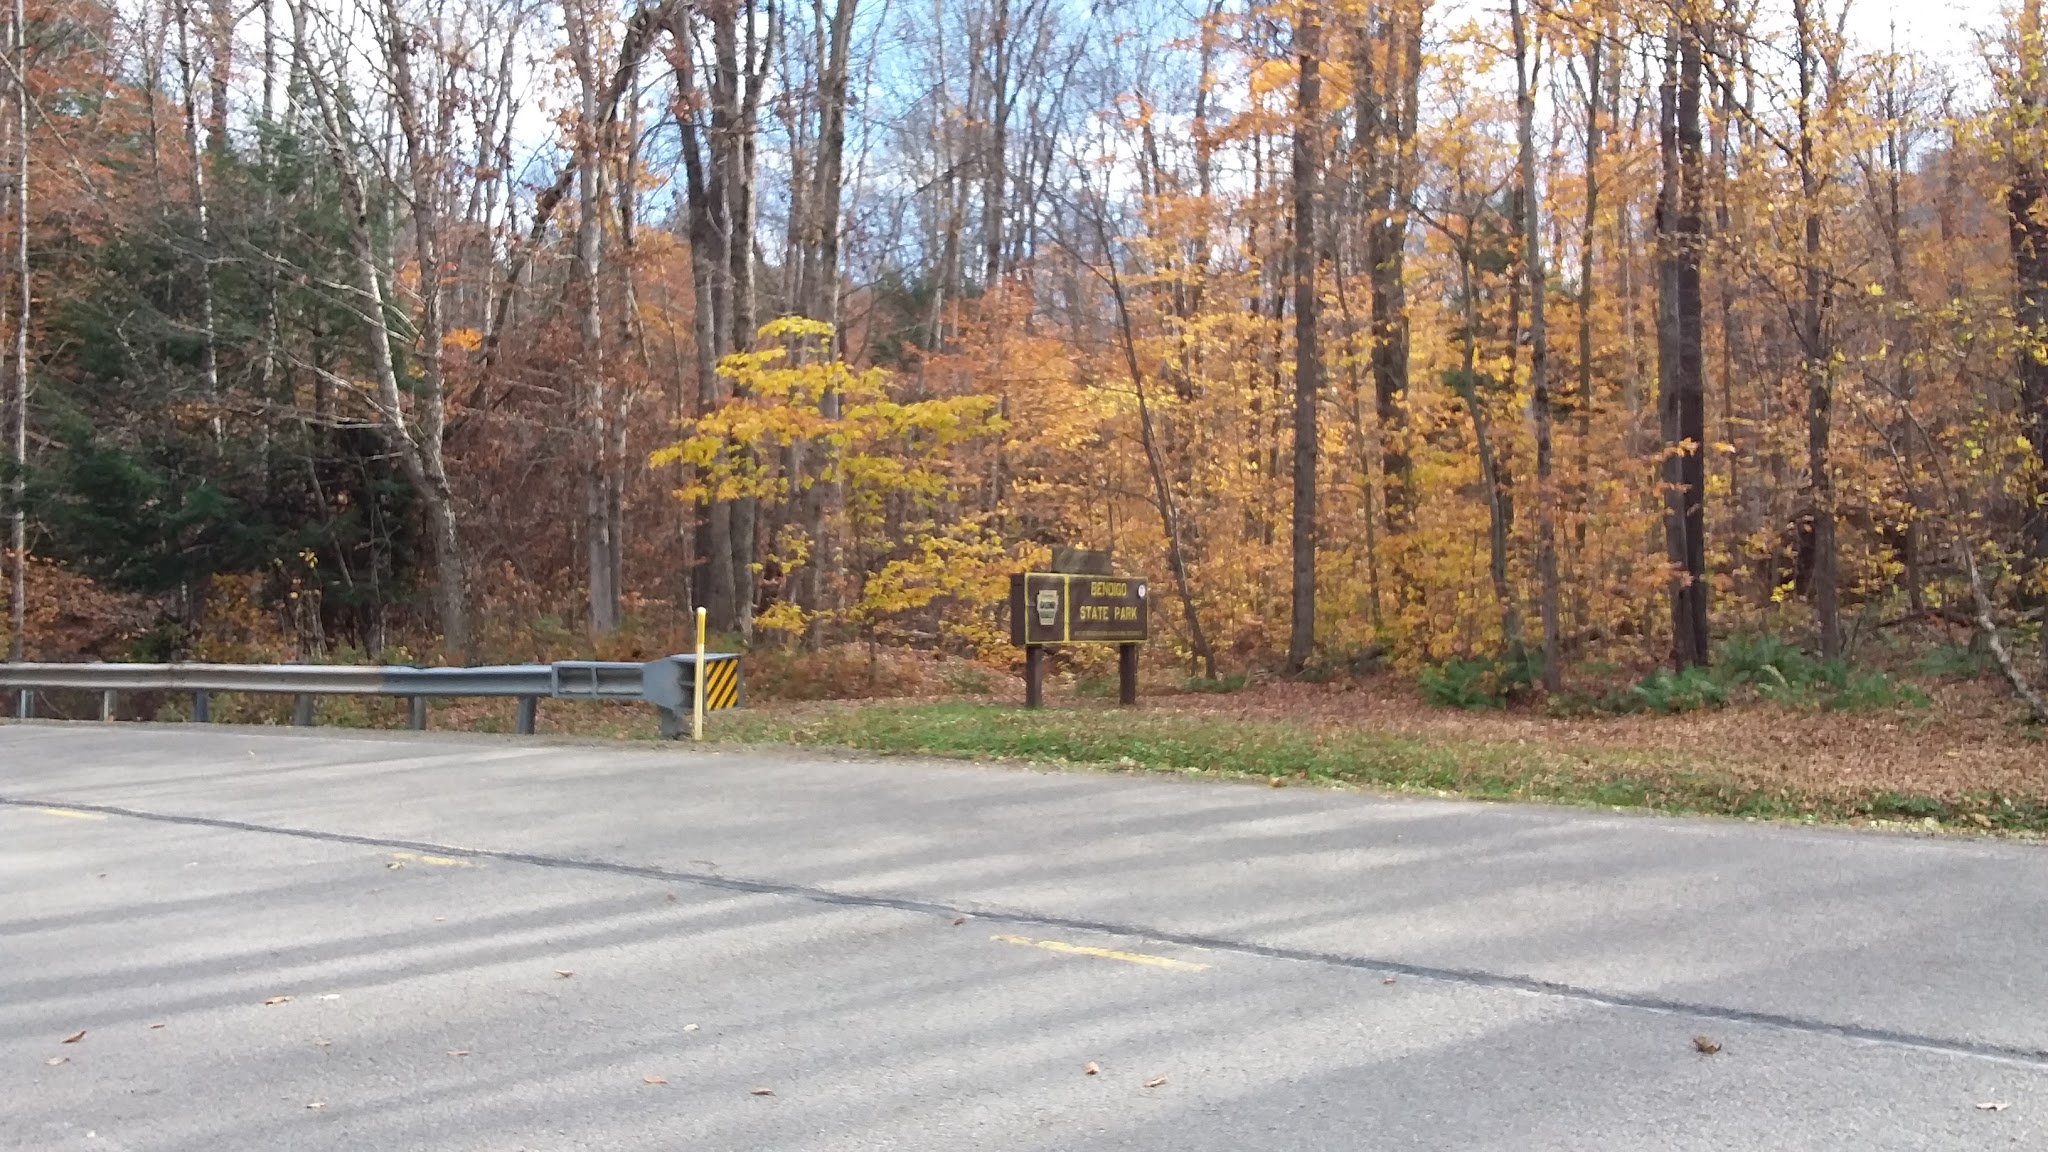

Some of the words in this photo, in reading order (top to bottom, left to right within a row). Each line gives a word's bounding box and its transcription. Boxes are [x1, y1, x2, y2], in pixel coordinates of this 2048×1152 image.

[1090, 581, 1127, 597] BENDIGO
[1080, 605, 1109, 620] STATE
[1114, 606, 1138, 620] PARK
